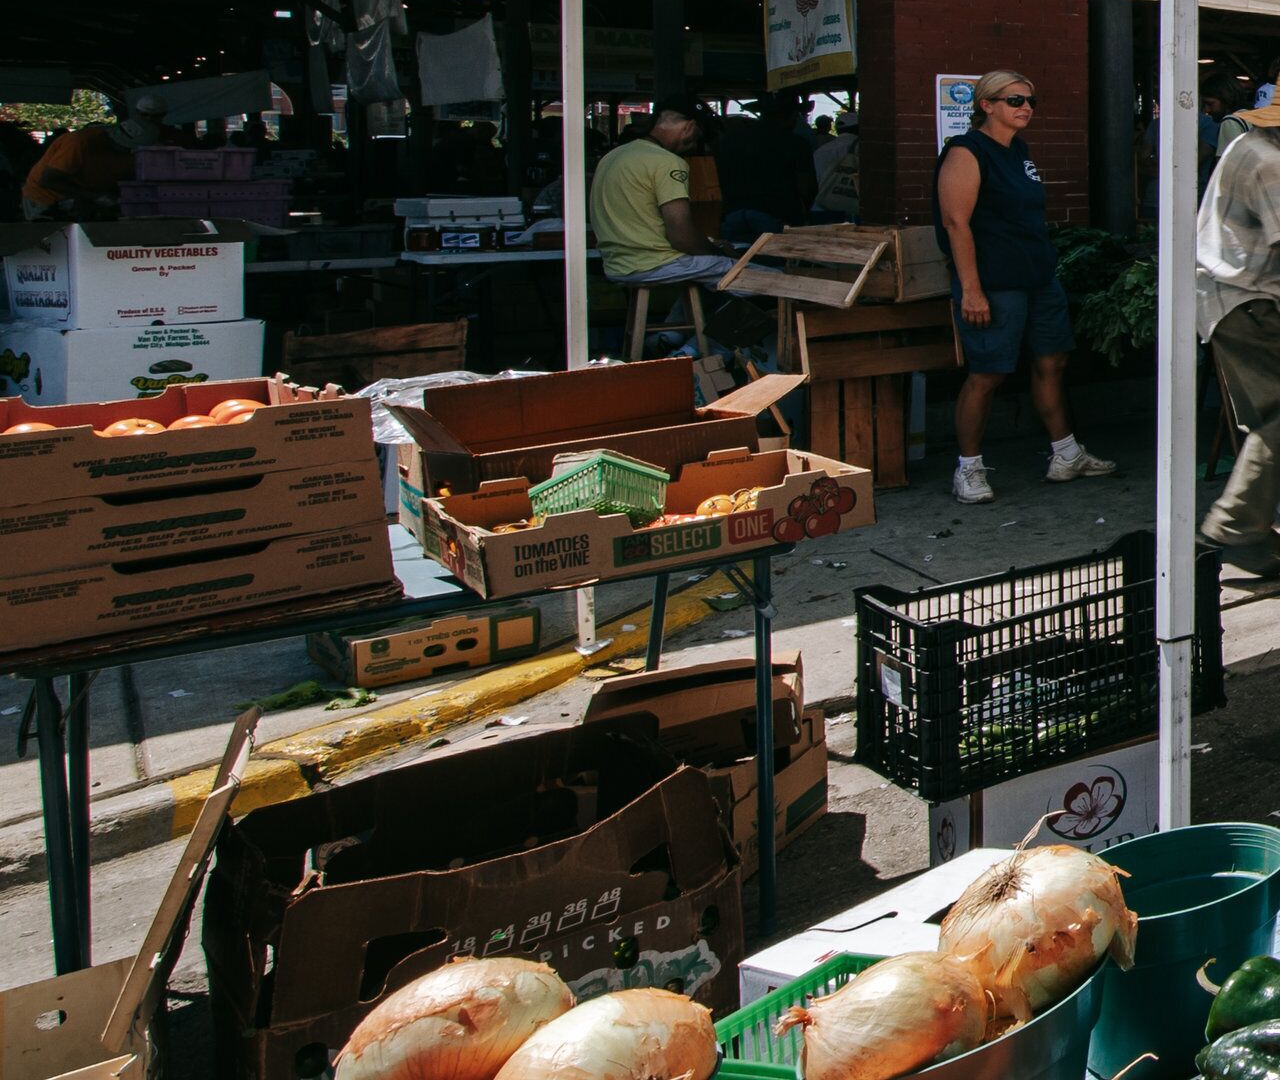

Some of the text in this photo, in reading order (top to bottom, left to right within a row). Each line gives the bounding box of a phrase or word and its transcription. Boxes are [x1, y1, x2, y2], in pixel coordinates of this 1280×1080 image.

[107, 247, 218, 260] QUALITY VEGETABLES
[73, 452, 168, 468] VINE RIPENED
[127, 458, 276, 482] STANDARD QUALITY BRAND
[120, 540, 168, 552] MARQUE
[172, 538, 188, 546] DE
[236, 522, 293, 536] STANDARD
[146, 532, 175, 542] SUR
[178, 527, 210, 538] PIED
[650, 524, 713, 557] SELECT
[734, 512, 769, 539] ONE
[513, 534, 590, 562] TOMATOES
[514, 550, 590, 578] on the VINE
[156, 600, 184, 610] SUR
[188, 594, 218, 604] PIED
[244, 585, 302, 600] STANDARD
[452, 626, 478, 637] GROS
[451, 936, 476, 952] 18
[527, 911, 552, 926] 30
[564, 898, 588, 916] 36
[598, 887, 622, 904] 48
[540, 915, 671, 962] PICKED
